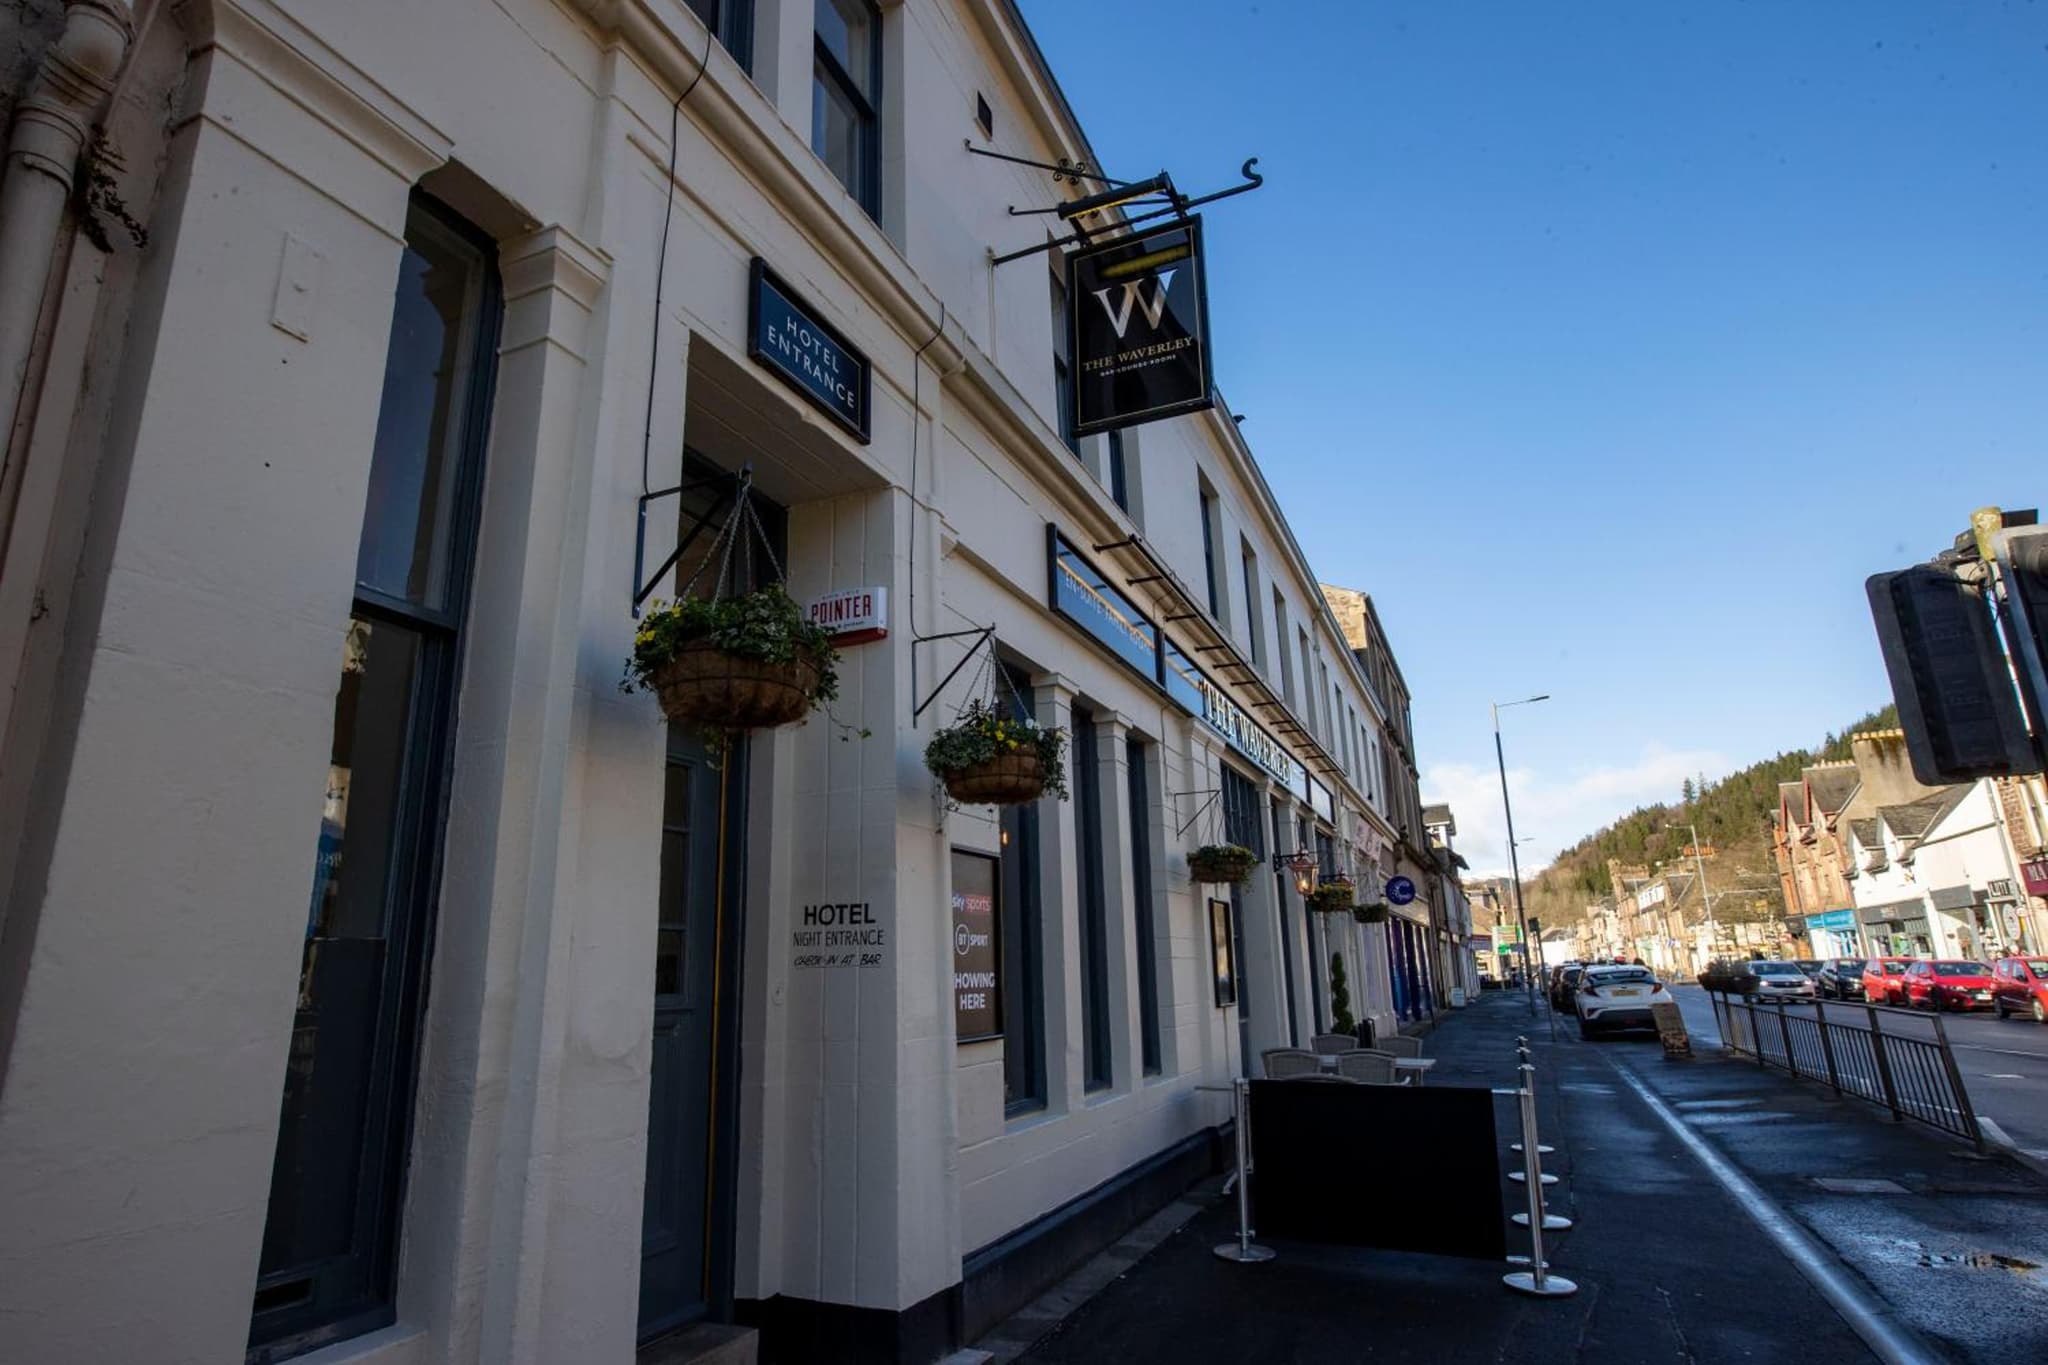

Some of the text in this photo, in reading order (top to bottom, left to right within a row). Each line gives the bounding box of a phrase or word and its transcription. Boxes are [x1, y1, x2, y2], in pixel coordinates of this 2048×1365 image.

[1092, 268, 1178, 338] W
[787, 316, 839, 374] HOTEL
[1083, 336, 1192, 371] THE WAVERLEY
[768, 325, 855, 408] ENTRANCE
[811, 594, 871, 625] POINTER
[804, 903, 876, 925] HOTEL
[966, 896, 992, 912] sports
[793, 929, 885, 947] NIGHT ENTRANCE
[860, 954, 882, 966] BAR
[953, 972, 995, 989] HOWING
[960, 994, 986, 1010] HERE
